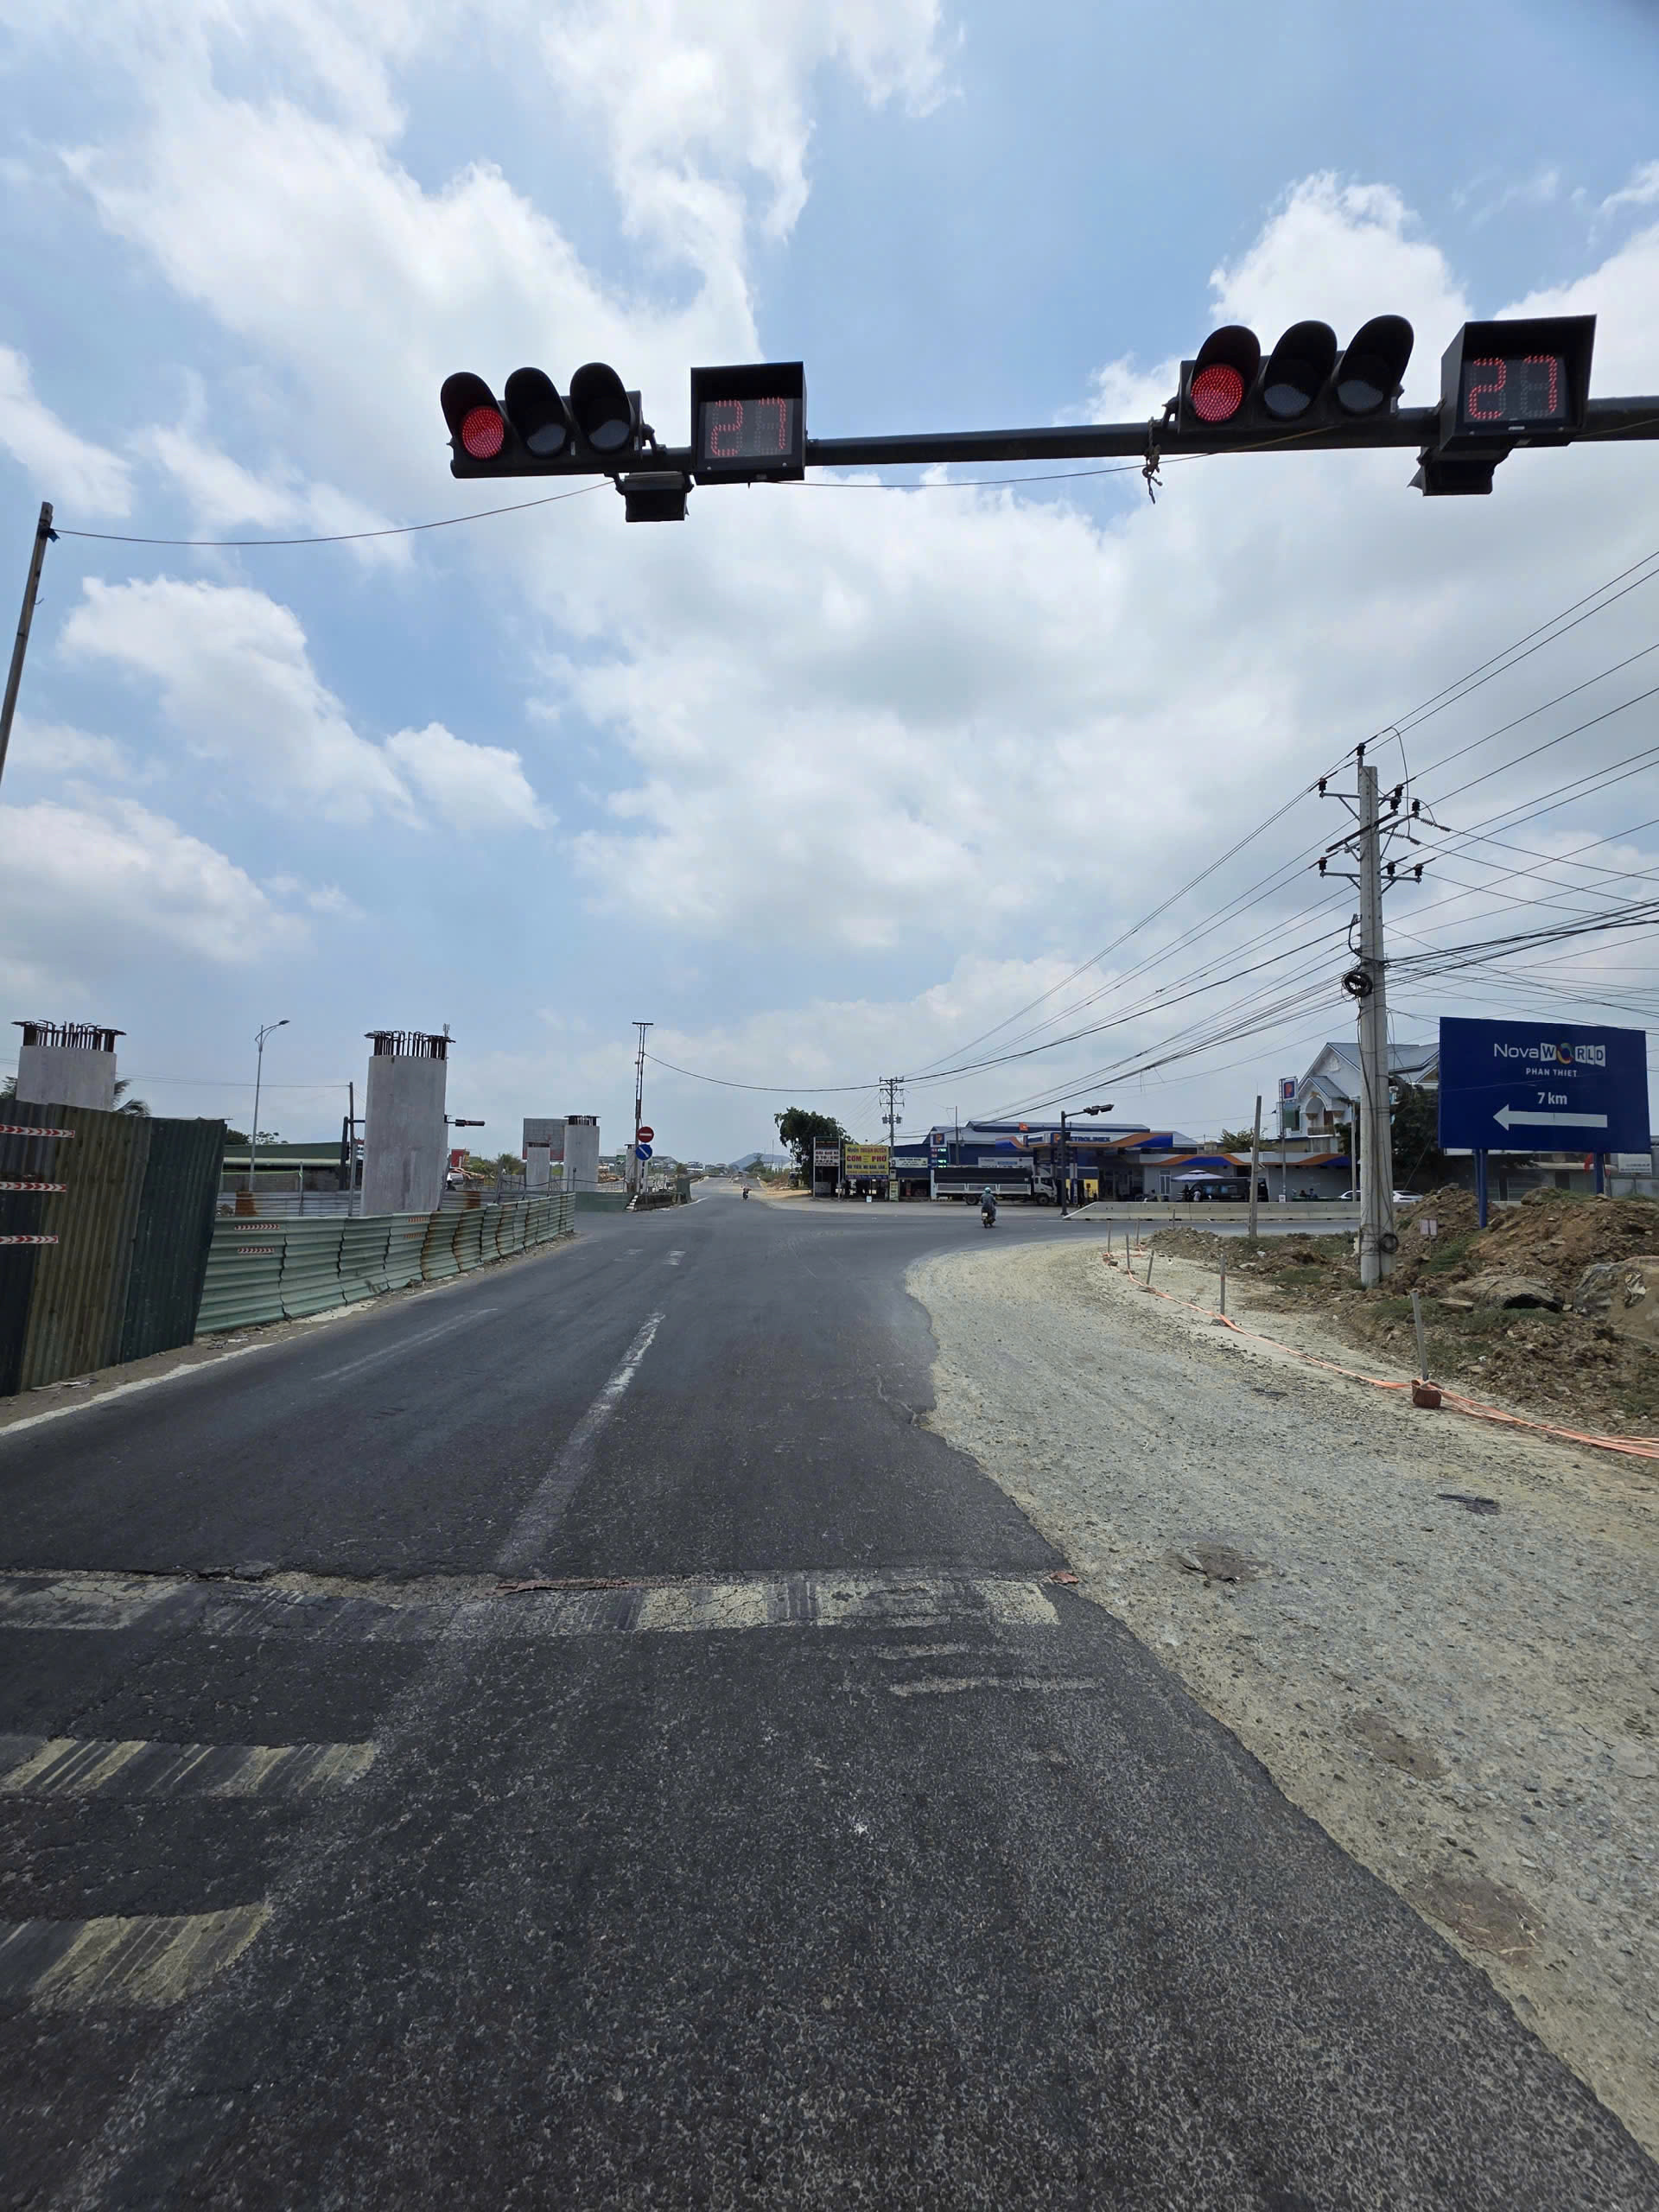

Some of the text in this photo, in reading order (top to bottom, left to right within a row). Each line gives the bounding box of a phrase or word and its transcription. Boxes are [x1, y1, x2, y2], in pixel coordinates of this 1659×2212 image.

[1469, 355, 1557, 420] 27
[710, 397, 786, 457] 27
[1525, 1067, 1550, 1076] PHAN
[1537, 1091, 1568, 1105] 7 km
